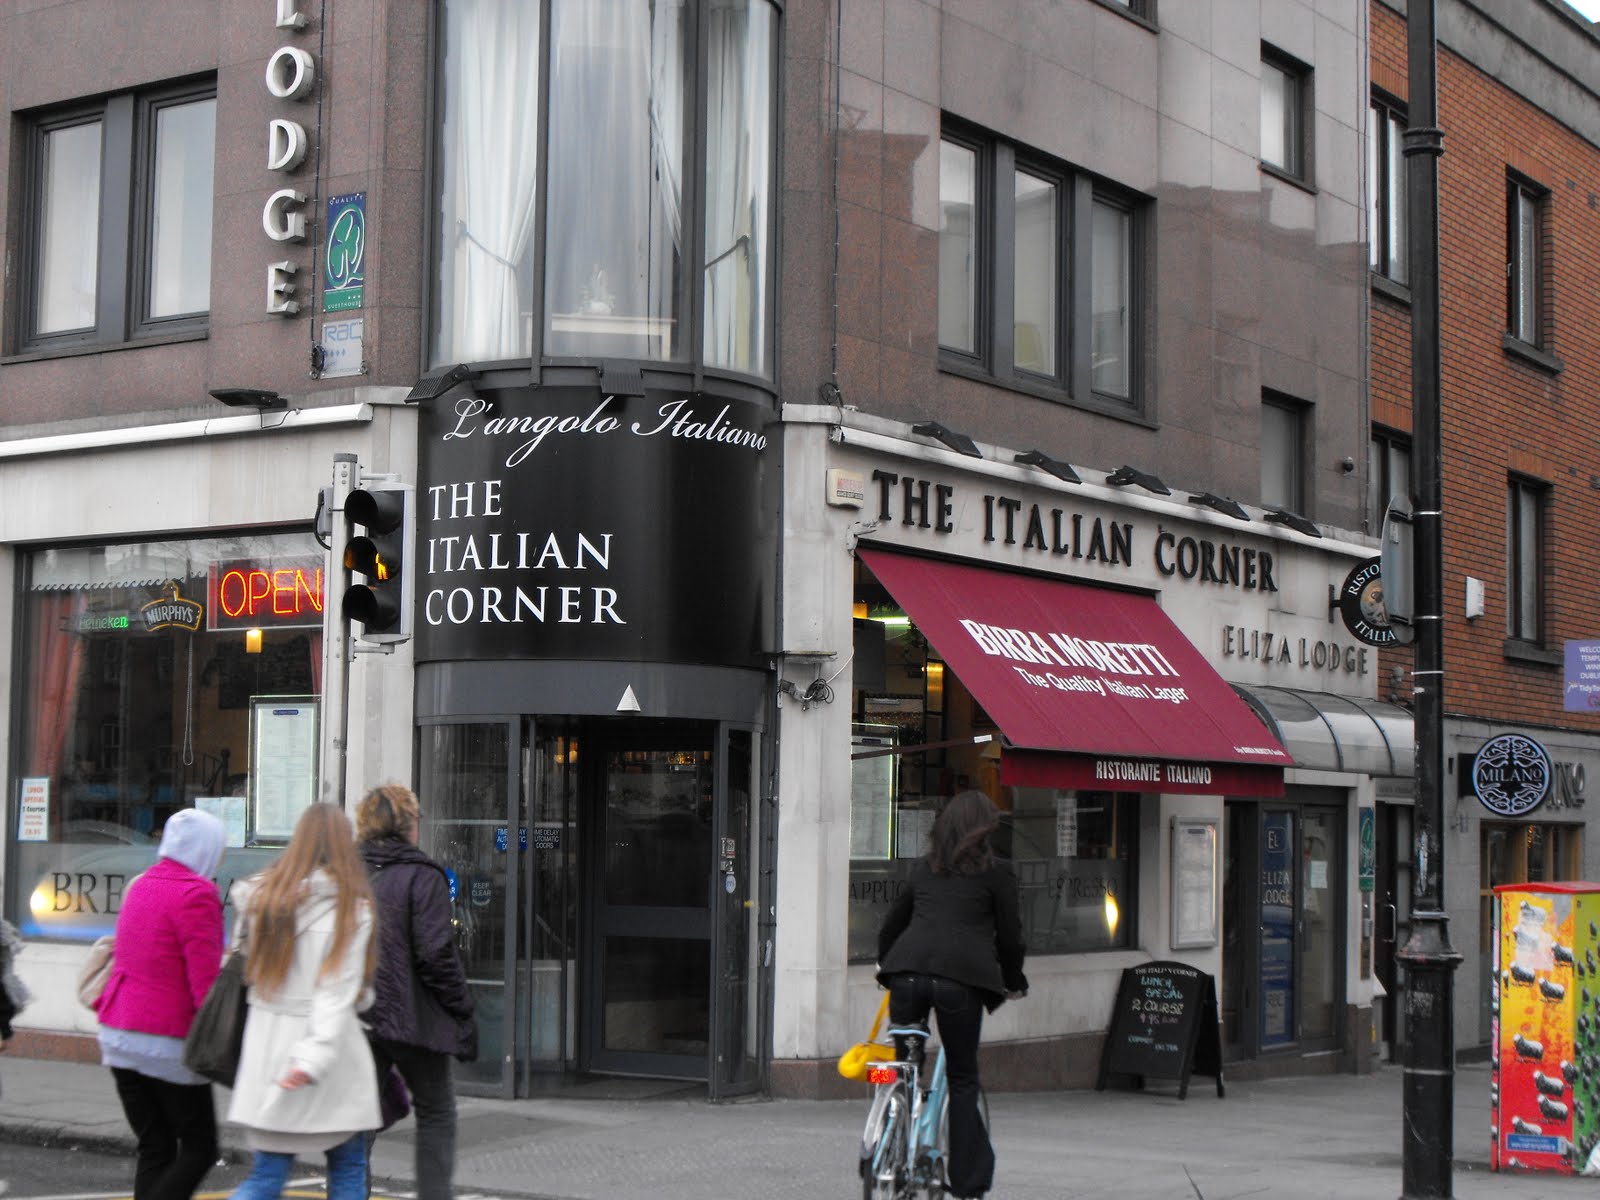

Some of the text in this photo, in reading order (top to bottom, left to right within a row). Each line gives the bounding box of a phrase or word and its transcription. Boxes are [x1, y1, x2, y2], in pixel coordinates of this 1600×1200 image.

[329, 195, 364, 206] QUALITY
[327, 300, 361, 310] GUESTHOUSE
[443, 395, 767, 468] L'angolo Italiano
[428, 480, 502, 521] THE
[873, 469, 1278, 593] THE ITALIAN CORNER
[428, 532, 613, 575] ITALIAN
[221, 569, 322, 617] OPEN
[1348, 563, 1381, 596] RISTO
[80, 615, 129, 630] Heineken
[425, 586, 627, 626] CORNER
[959, 619, 1180, 677] BIRRA MORETTI
[1355, 620, 1396, 642] ITALIA
[1222, 625, 1368, 675] ELIZA LODGE
[1012, 666, 1190, 704] The Quality Italian Lager
[1096, 760, 1212, 785] RISTORANTE ITALIANO
[1480, 768, 1543, 782] MILANO
[473, 882, 490, 890] KEEP
[1172, 968, 1198, 978] CORNER
